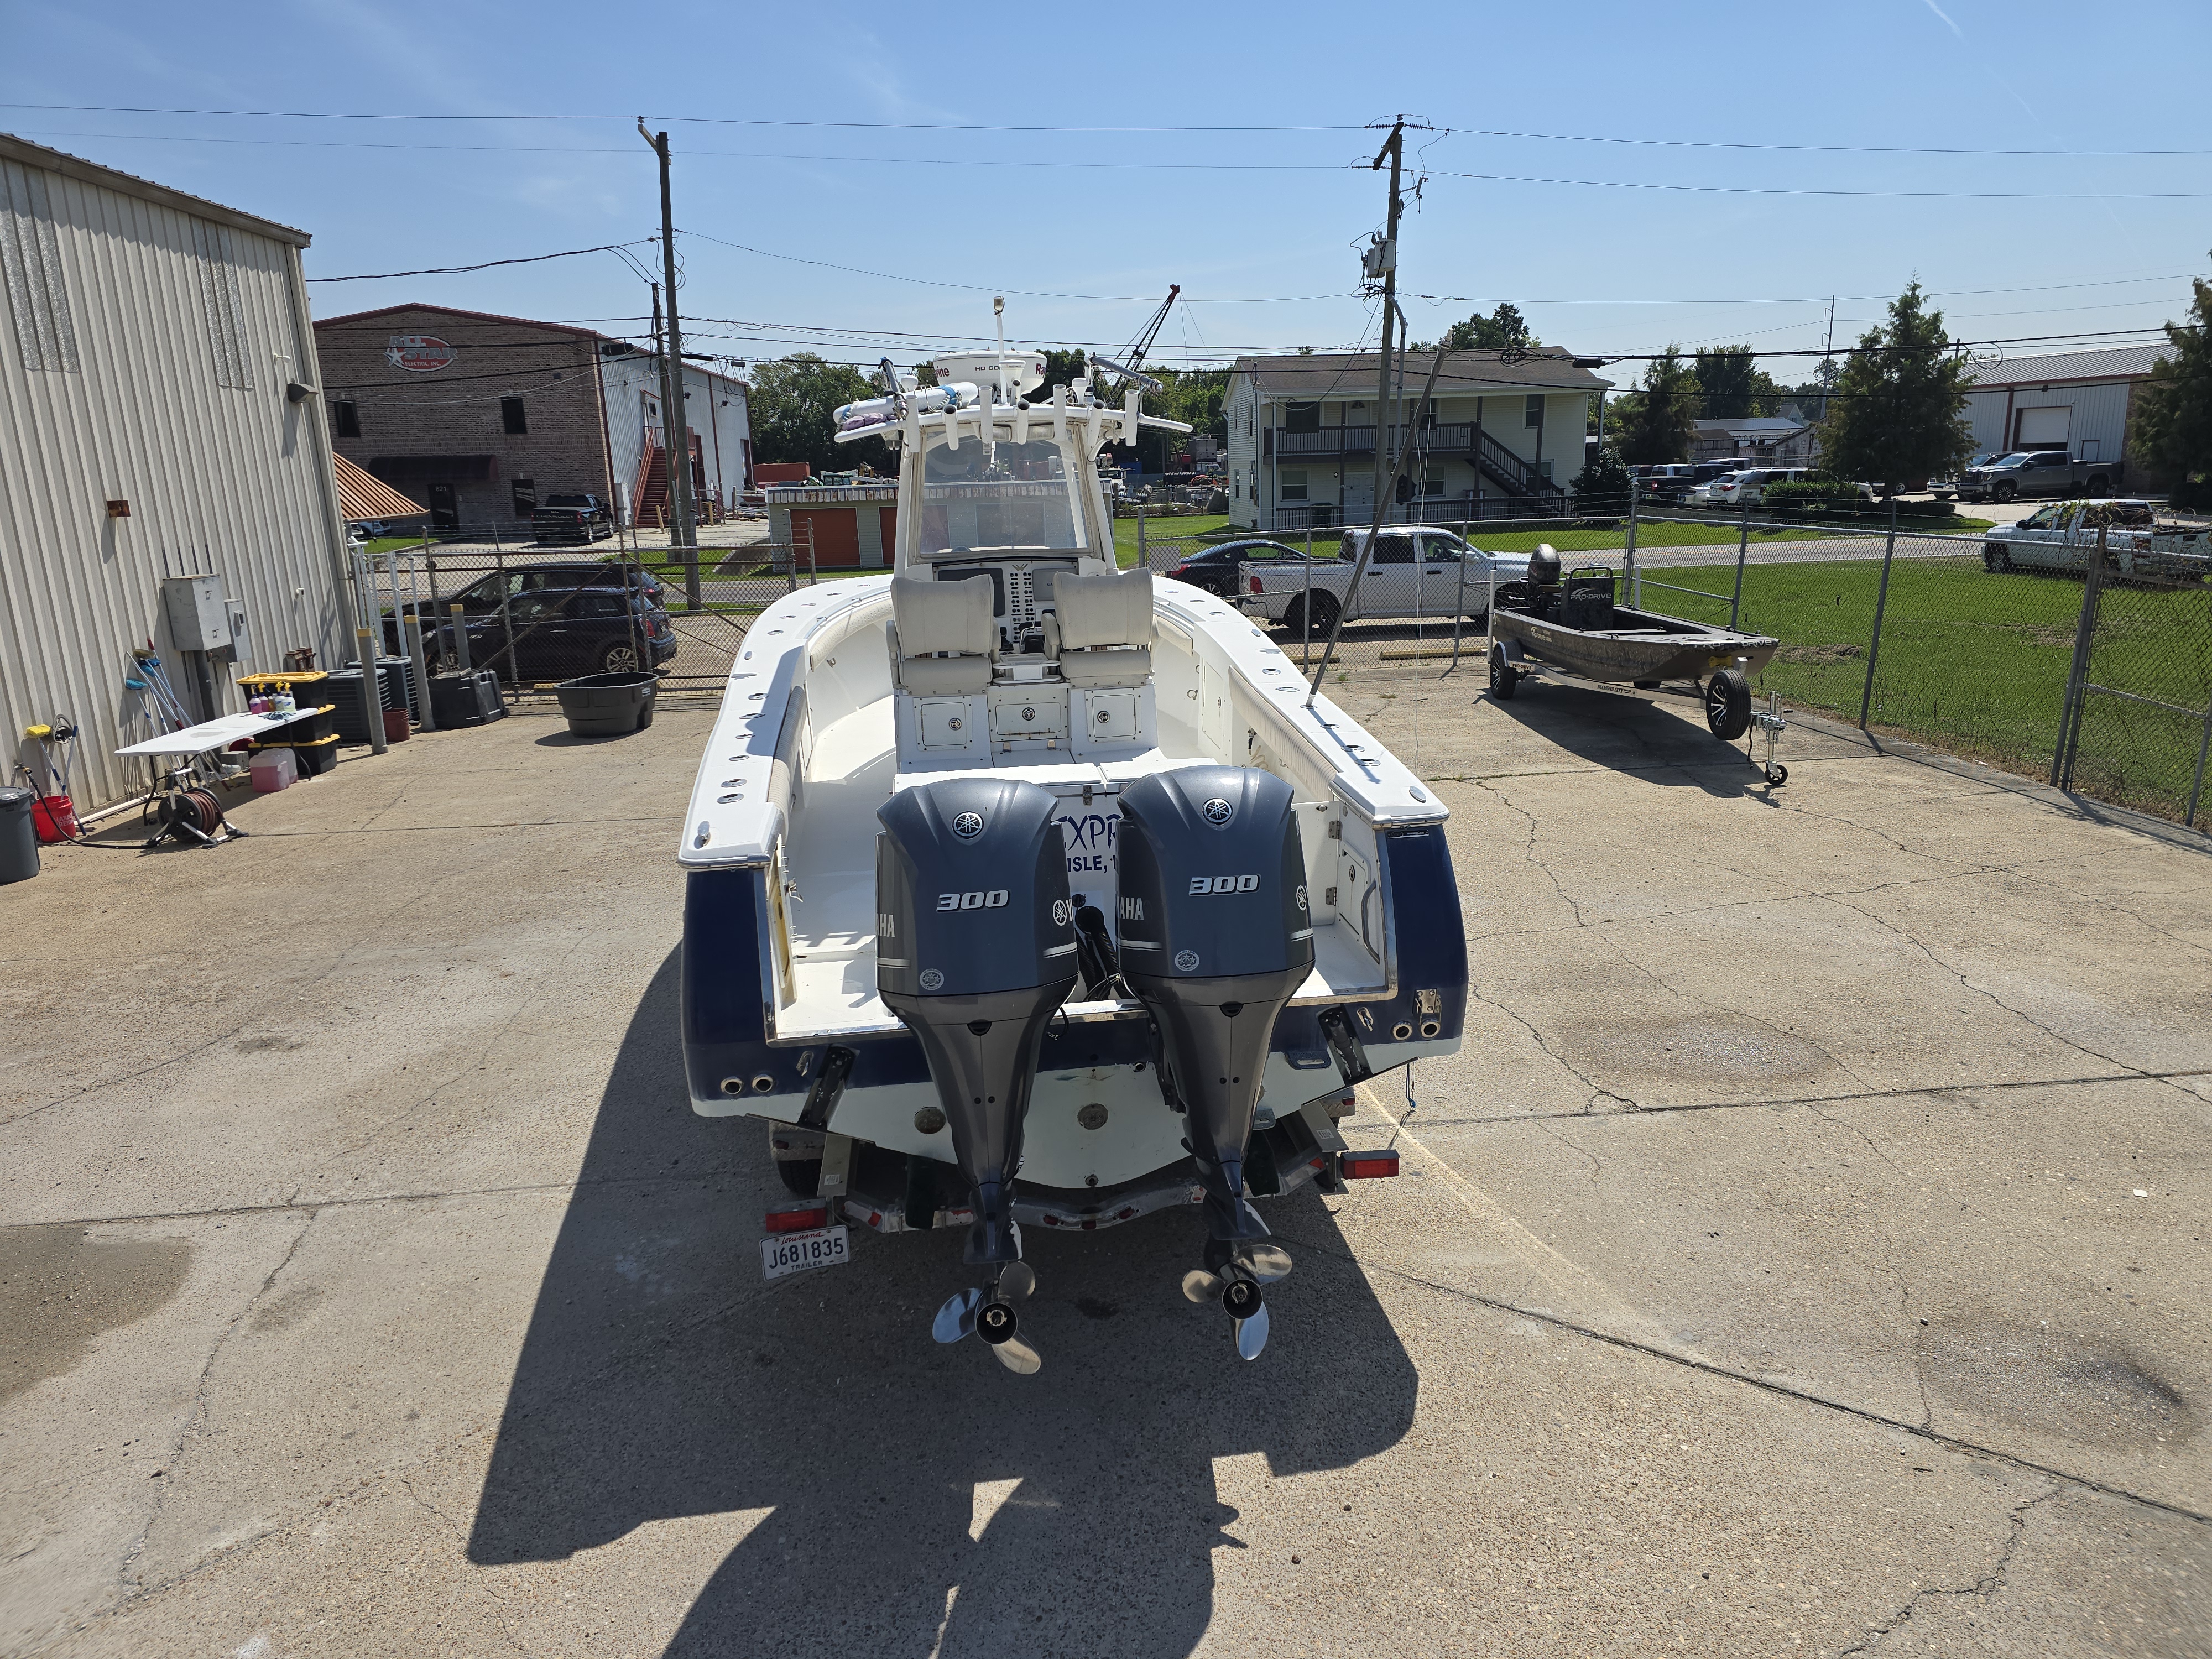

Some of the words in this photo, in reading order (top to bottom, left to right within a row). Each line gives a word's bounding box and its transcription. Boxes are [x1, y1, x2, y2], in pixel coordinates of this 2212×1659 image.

[389, 336, 426, 347] ALL
[404, 348, 460, 359] STAR
[1067, 855, 1107, 873] ISLE,
[1189, 874, 1258, 894] 300
[936, 890, 1009, 911] 300
[781, 1232, 826, 1245] Louisiana
[769, 1237, 843, 1269] J681835
[790, 1260, 822, 1271] TRAILER
